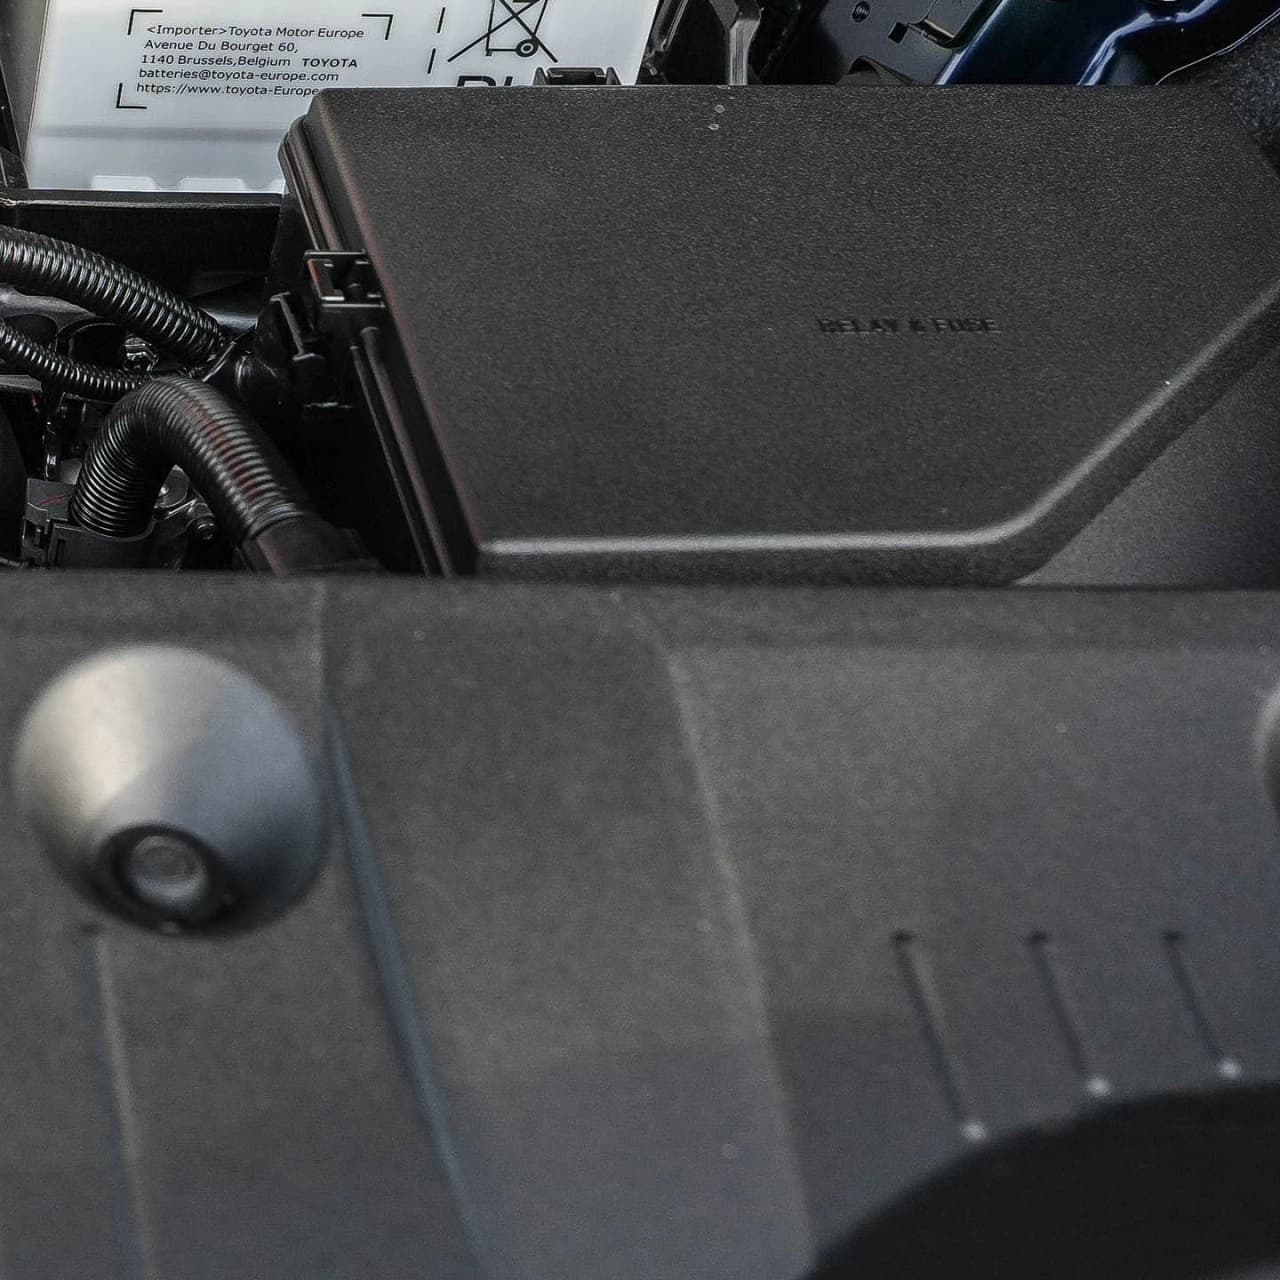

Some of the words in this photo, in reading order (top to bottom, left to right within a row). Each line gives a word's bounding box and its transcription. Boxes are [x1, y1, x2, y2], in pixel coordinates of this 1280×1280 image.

[275, 26, 316, 39] Motor
[317, 27, 365, 42] Europe
[143, 39, 194, 52] Avenue
[197, 40, 218, 52] Du
[220, 40, 275, 57] Bourget
[277, 42, 300, 56] 60,
[141, 54, 176, 66] 1140
[301, 58, 359, 69] TOYOTA
[138, 67, 341, 85] batteries@toyota-europe.com
[817, 318, 900, 335] RELAY
[934, 318, 1001, 335] FUSE
